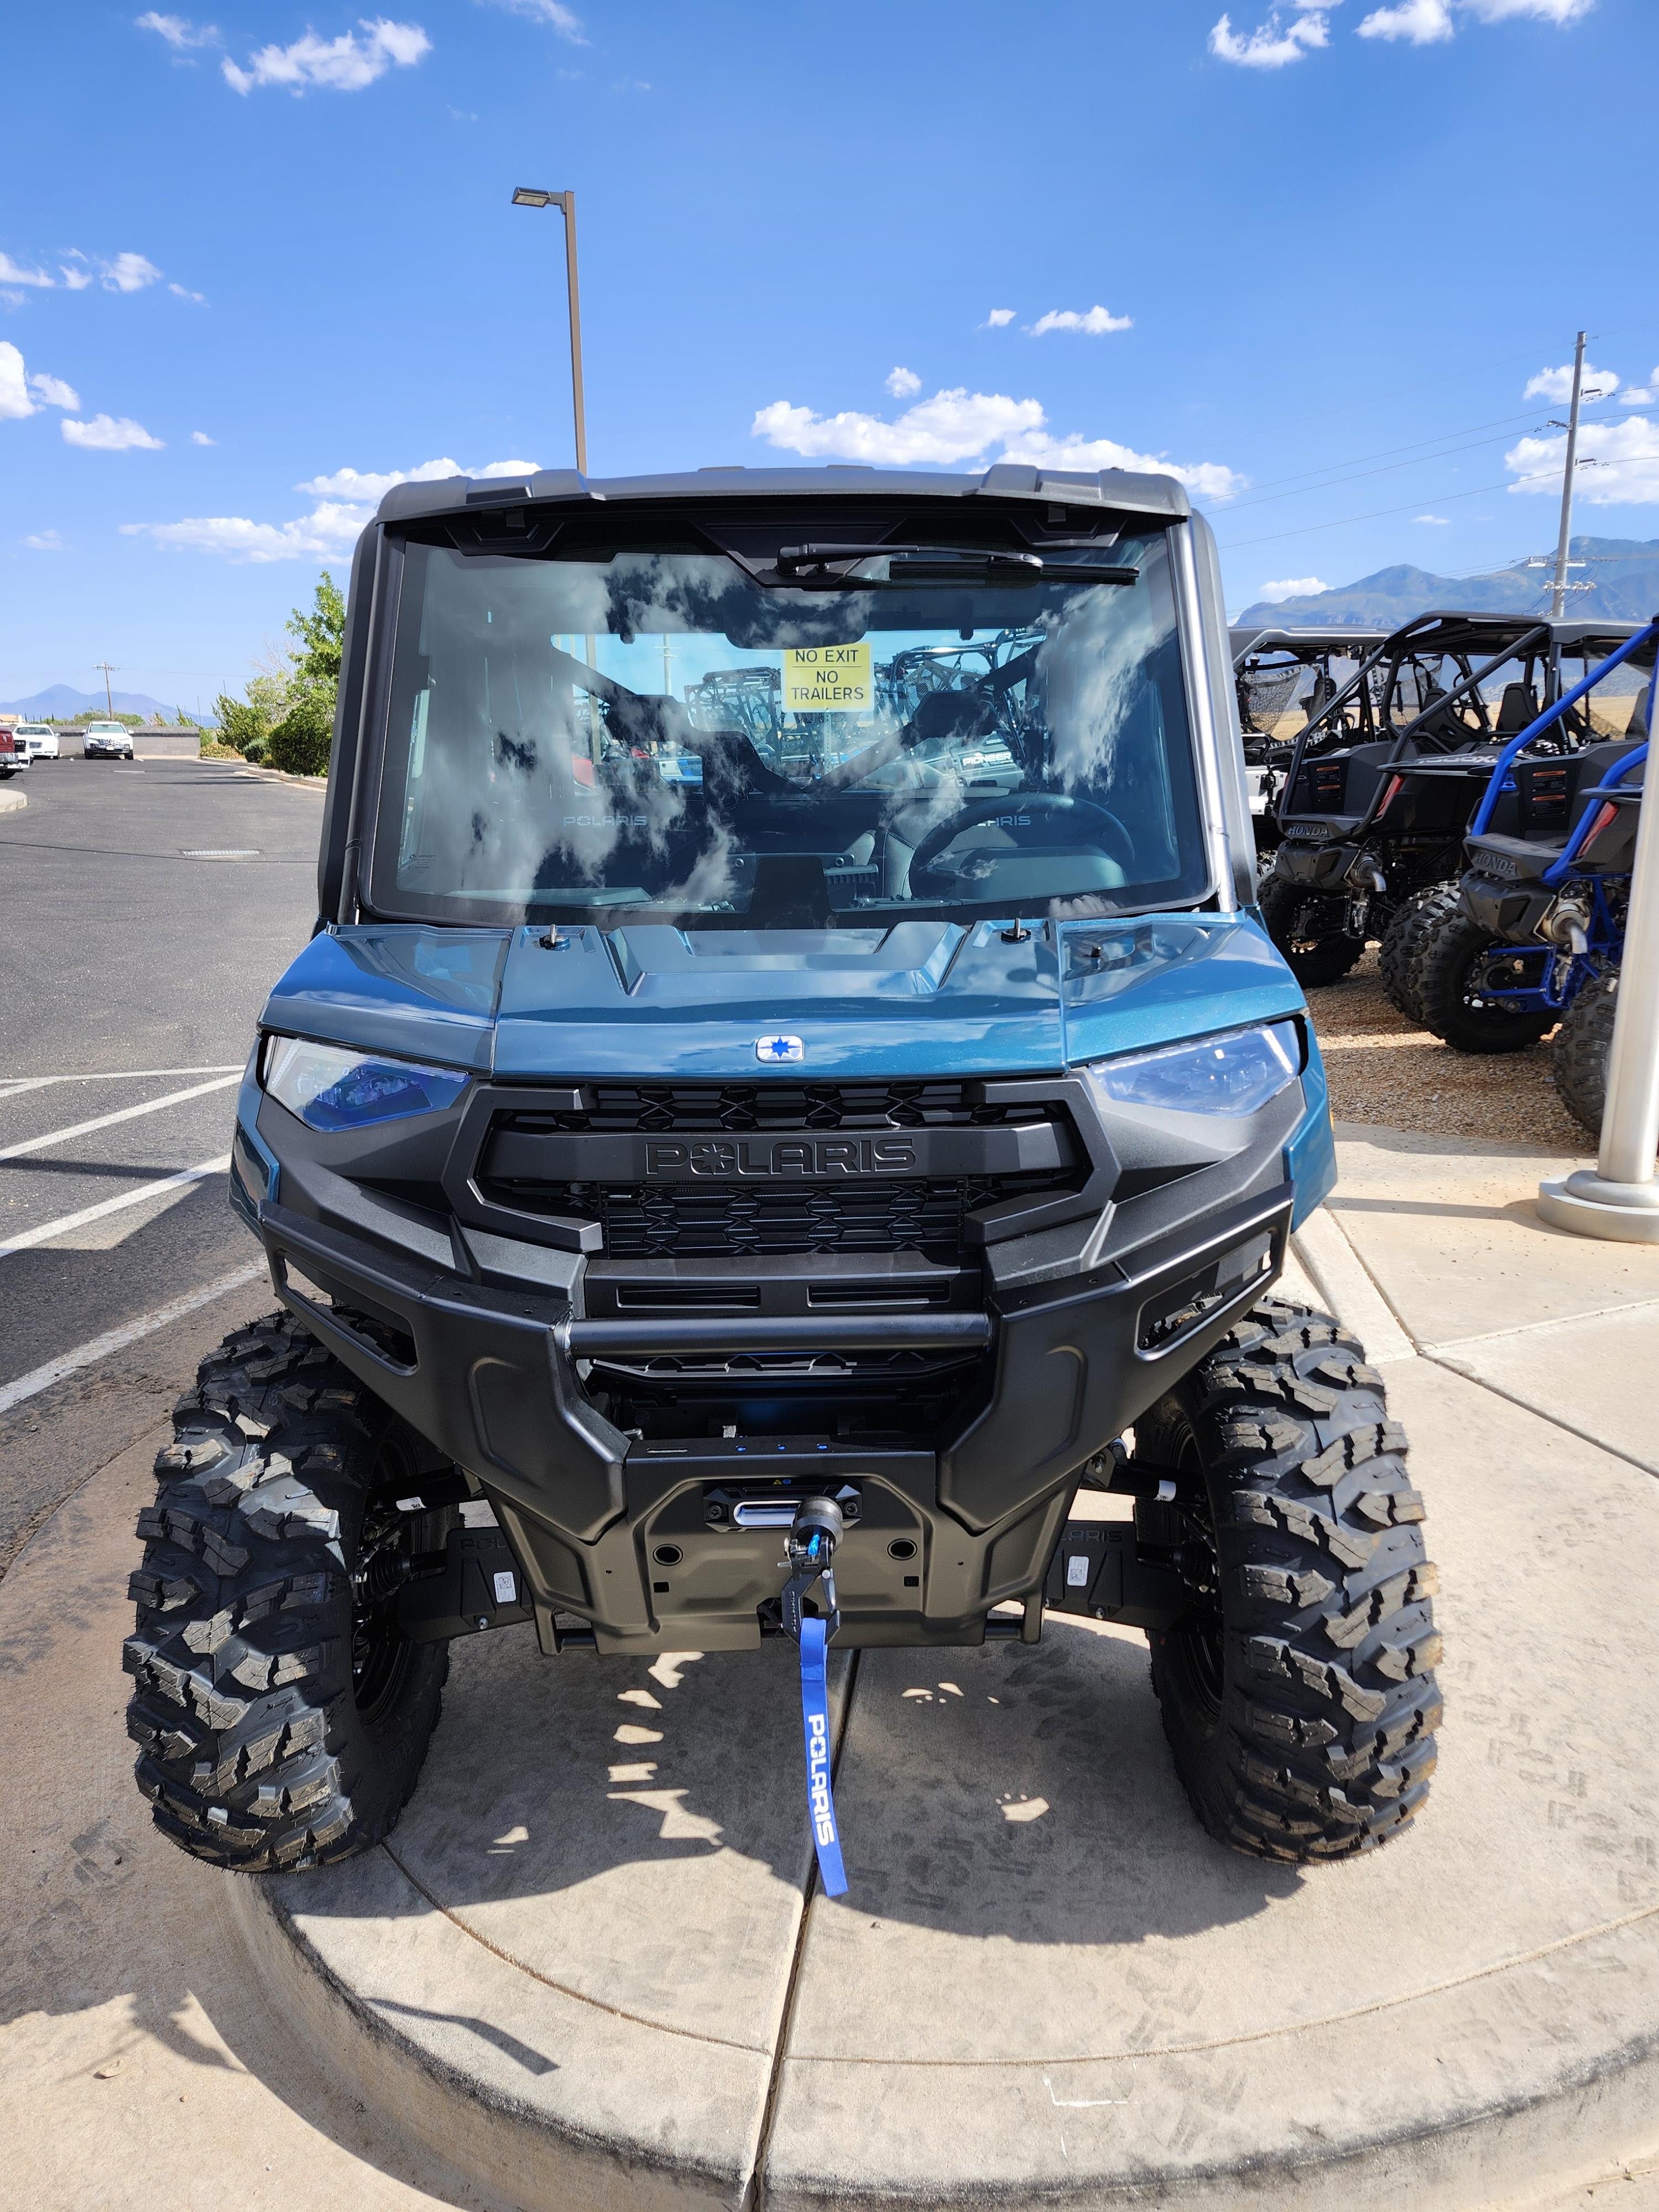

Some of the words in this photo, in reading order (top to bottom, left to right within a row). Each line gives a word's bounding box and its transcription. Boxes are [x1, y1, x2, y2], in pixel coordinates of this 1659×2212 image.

[795, 650, 817, 662] NO
[826, 650, 858, 662] EXIT
[816, 671, 838, 683] NO
[791, 687, 864, 700] TRAILERS
[962, 752, 1011, 766] PIONEER
[563, 815, 648, 827] POLARIS
[1287, 825, 1329, 838] HONDA
[1475, 852, 1517, 877] HONDA
[645, 1138, 916, 1175] POLARIS
[808, 1714, 834, 1846] POLARIS
